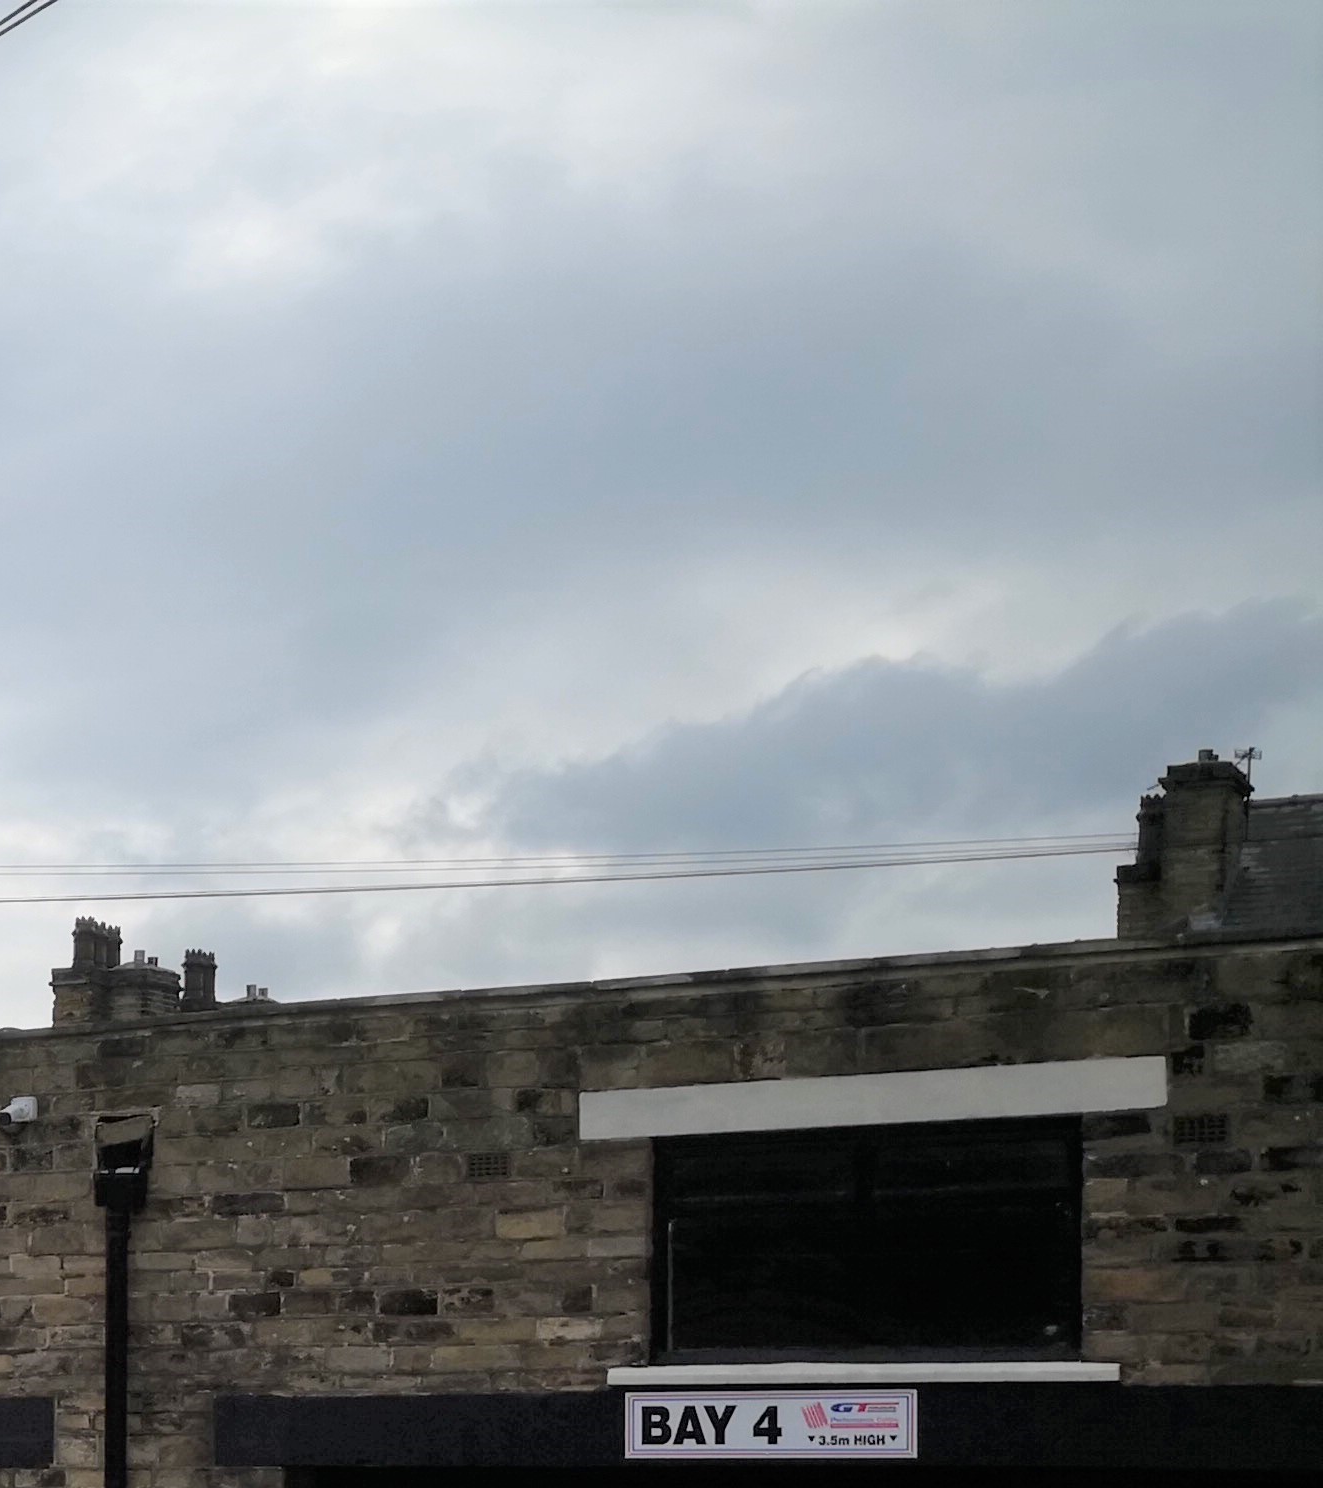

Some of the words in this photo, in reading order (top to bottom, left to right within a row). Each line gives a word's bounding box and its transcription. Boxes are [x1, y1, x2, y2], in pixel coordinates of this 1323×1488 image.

[640, 1405, 738, 1445] BAY
[753, 1405, 782, 1445] 4
[819, 1435, 850, 1445] 3.5m
[854, 1435, 886, 1445] HIGH
